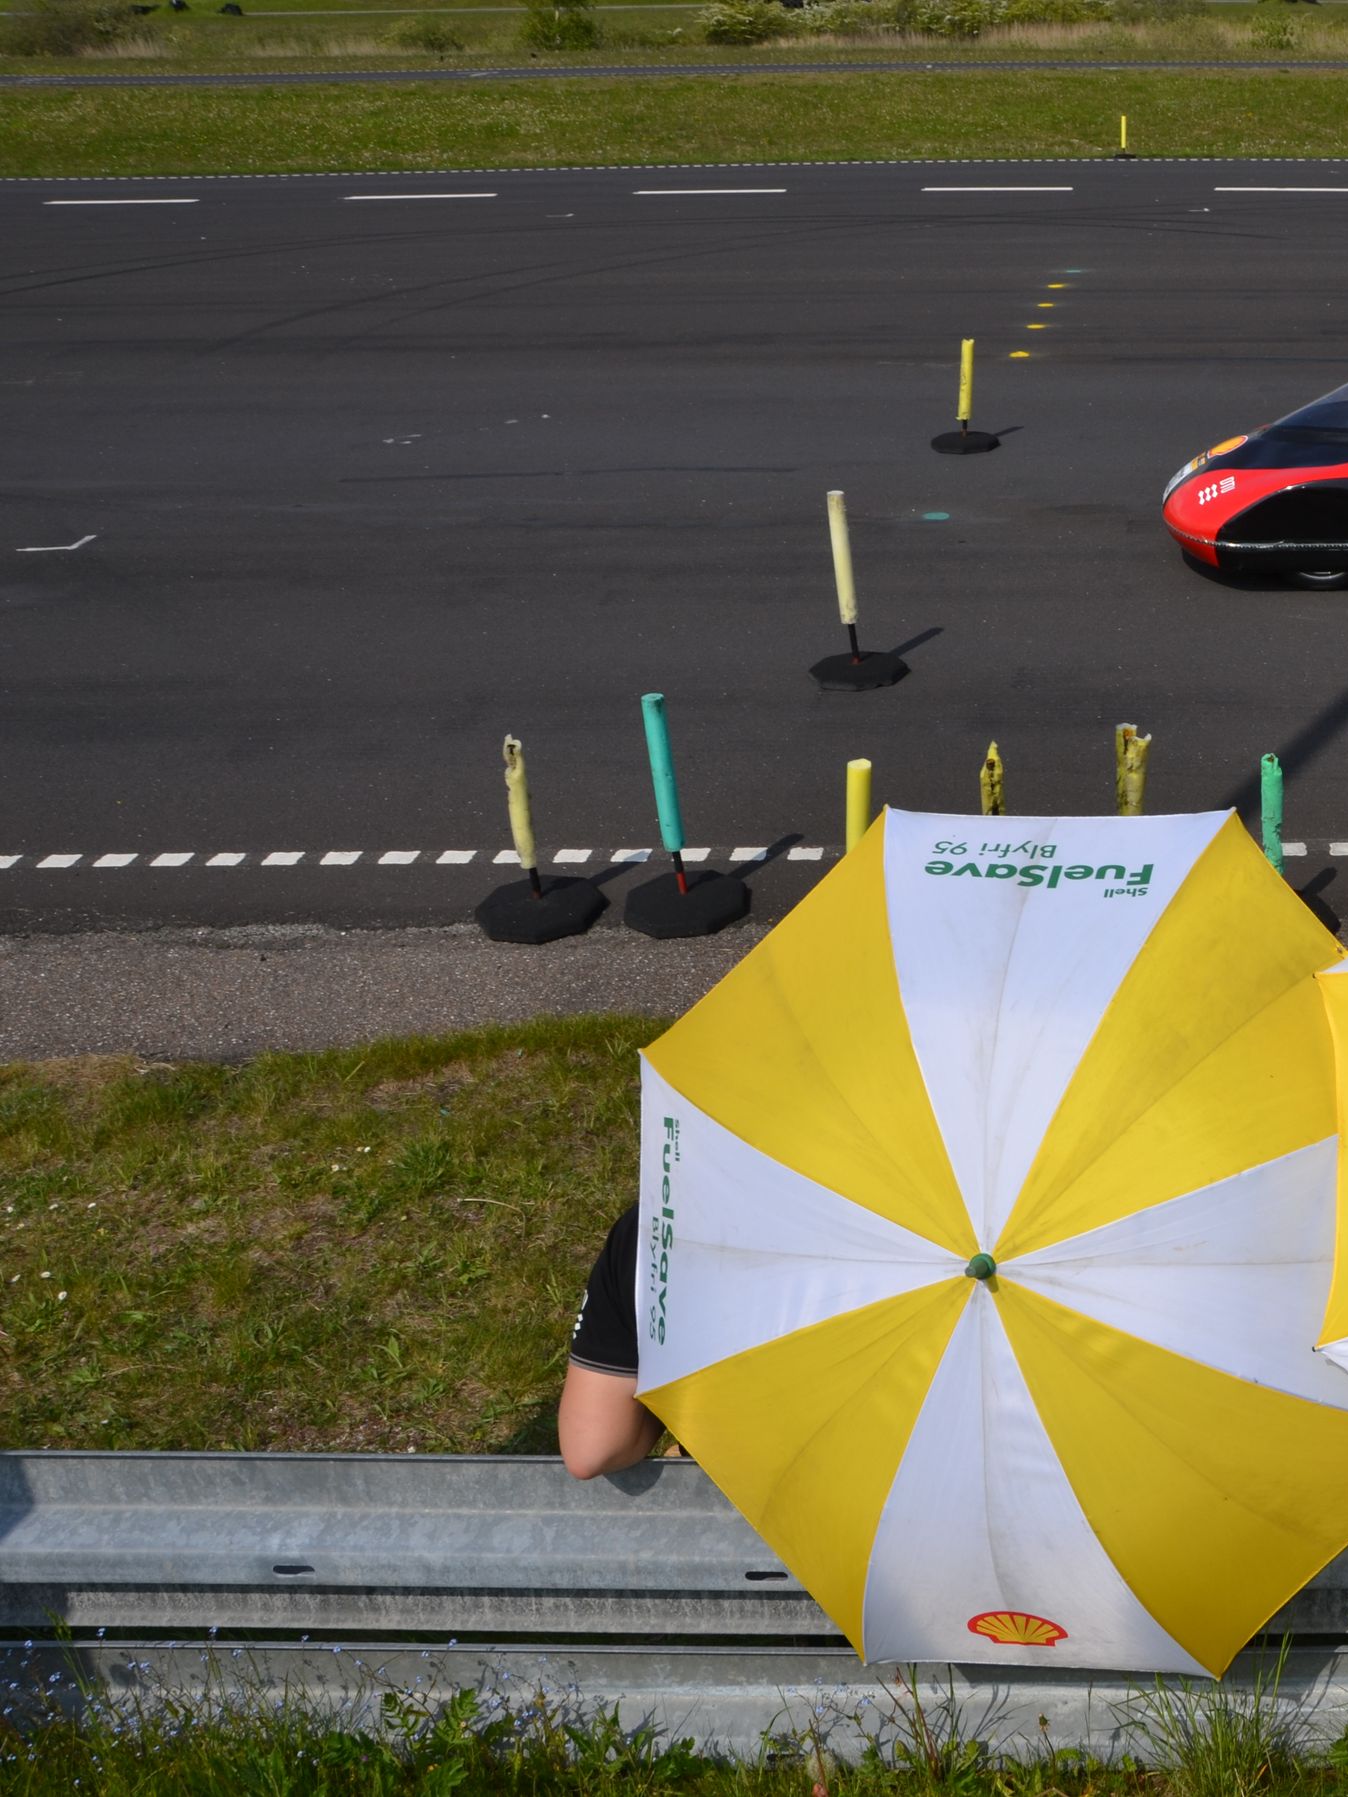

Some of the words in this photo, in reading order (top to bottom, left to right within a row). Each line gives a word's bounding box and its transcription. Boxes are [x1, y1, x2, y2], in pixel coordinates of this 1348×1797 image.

[932, 840, 968, 855] 95
[978, 840, 1057, 859] Blyfri
[924, 860, 1154, 889] FuelSave
[1103, 887, 1148, 898] Shell
[657, 1116, 675, 1346] FuelSave
